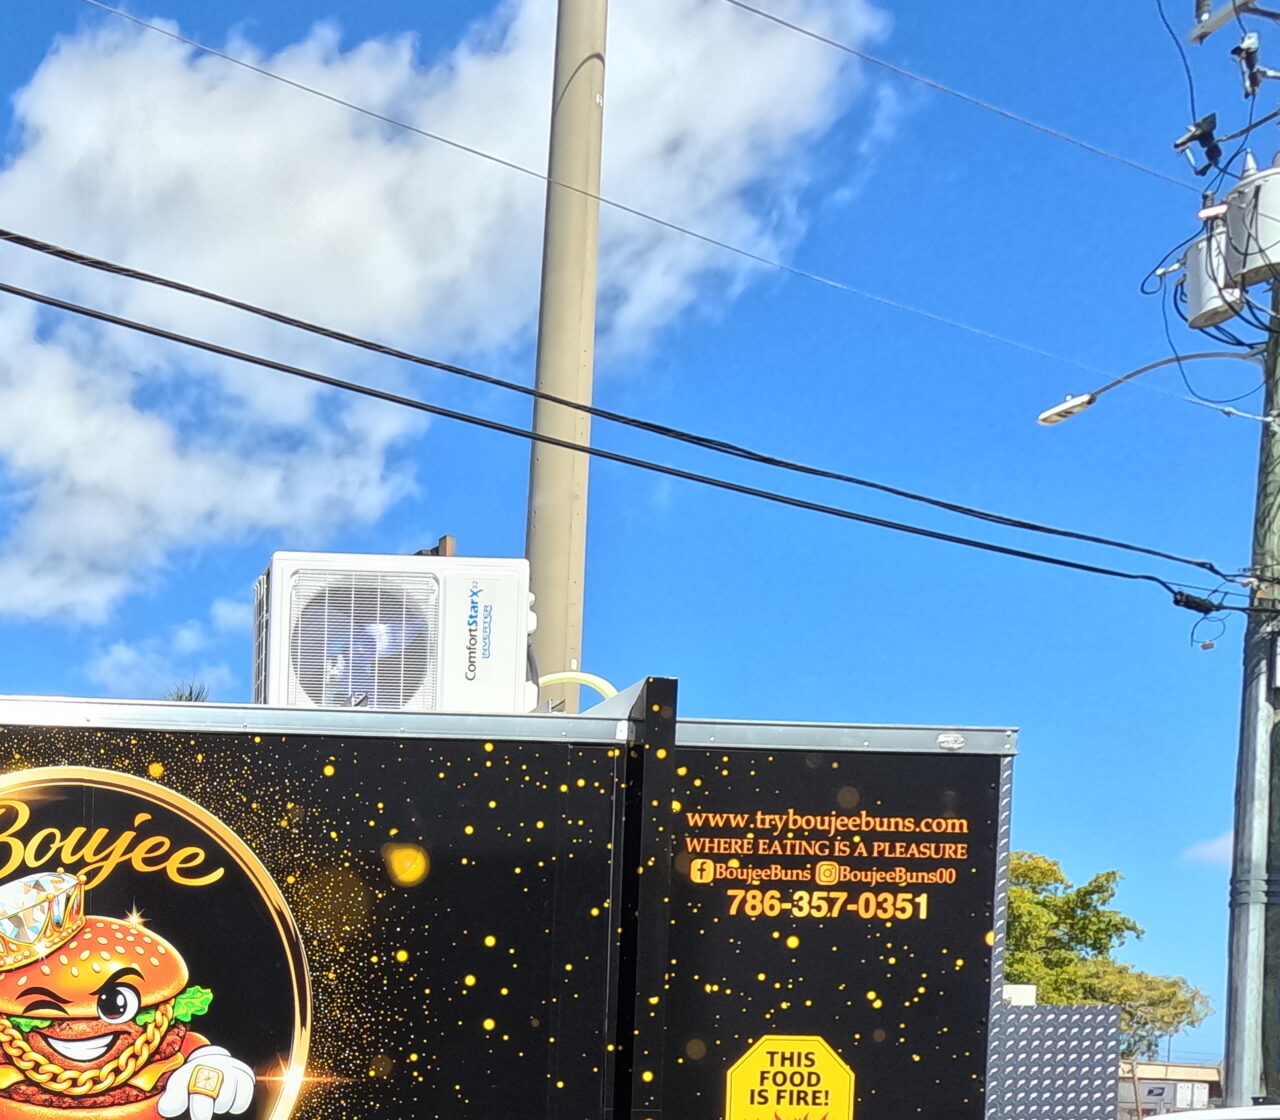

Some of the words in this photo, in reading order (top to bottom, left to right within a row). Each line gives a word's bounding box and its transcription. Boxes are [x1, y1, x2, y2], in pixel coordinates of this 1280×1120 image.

[481, 604, 493, 659] INVERTER
[685, 808, 969, 836] www.tryboujeebuns.com
[685, 837, 754, 854] WHERE
[758, 838, 830, 857] EATING
[834, 840, 850, 857] IS
[853, 841, 869, 858] A
[872, 842, 968, 860] PLEASURE
[715, 863, 812, 886] BoujeeBuns
[839, 865, 957, 888] BoujeeBuns00
[726, 889, 928, 920] 786-357-0351
[766, 1051, 816, 1068] THIS
[759, 1070, 821, 1087] FOOD
[749, 1089, 769, 1105] IS
[776, 1089, 830, 1106] FIRE!
